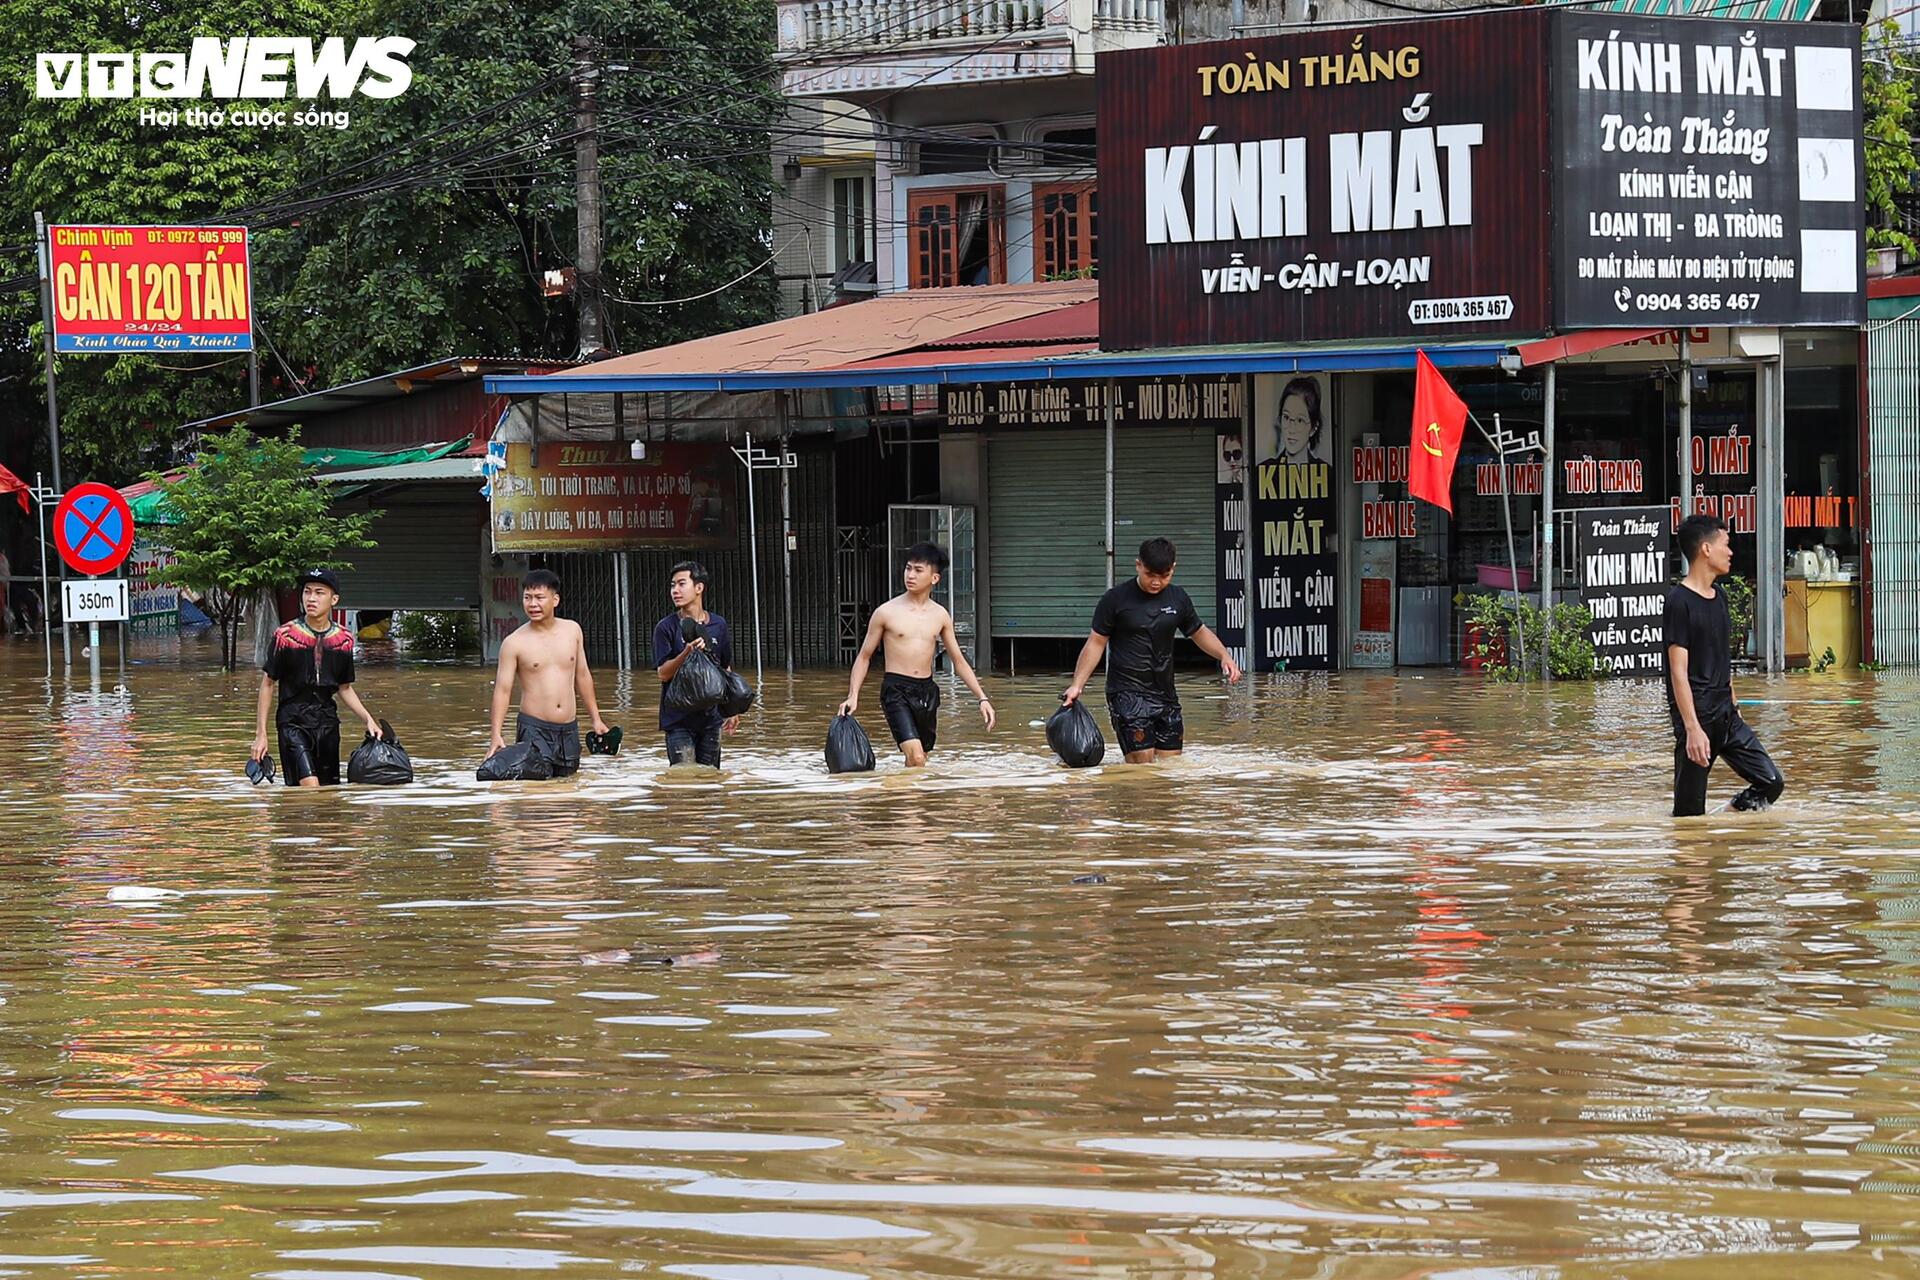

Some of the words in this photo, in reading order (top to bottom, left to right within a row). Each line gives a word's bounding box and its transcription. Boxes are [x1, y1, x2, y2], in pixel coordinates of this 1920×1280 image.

[1197, 52, 1290, 97] TOÀN
[1299, 34, 1420, 87] THẮNG
[1578, 30, 1681, 93] KÍNH
[1695, 30, 1786, 97] MẮT
[1600, 112, 1671, 153] Toàn
[1681, 109, 1770, 165] Thắng
[1145, 125, 1308, 244] KÍNH
[1329, 92, 1484, 233] MẮT
[1619, 168, 1664, 197] KÍNH
[1668, 165, 1709, 198] VIỄN
[1716, 170, 1752, 204] CẬN
[102, 229, 134, 250] Vịnh
[148, 231, 164, 243] ĐT:
[168, 231, 195, 243] 0972
[198, 231, 219, 243] 605
[222, 231, 242, 243] 999
[1589, 212, 1638, 242] LOẠN
[1643, 213, 1672, 242] THỊ
[1694, 214, 1720, 238] ĐA
[1724, 208, 1783, 238] TRÒNG
[56, 250, 122, 321] CÂN
[126, 263, 183, 321] 120
[185, 245, 246, 320] TẤN
[1200, 253, 1261, 294] VIỄN
[1278, 253, 1340, 294] CẬN
[1355, 256, 1431, 290] LOẠN
[1579, 258, 1594, 278] ĐO
[1597, 252, 1621, 278] MẮT
[1625, 250, 1655, 278] BẰNG
[1658, 254, 1683, 278] MÁY
[1685, 258, 1700, 278] ĐO
[1703, 255, 1729, 282] ĐIỆN
[1732, 251, 1747, 279] TỬ
[1748, 258, 1763, 282] TỰ
[1764, 255, 1794, 282] ĐỘNG
[1414, 304, 1431, 320] ĐT:
[1432, 302, 1460, 319] 0904
[1463, 301, 1484, 318] 365
[1487, 299, 1507, 316] 467
[1636, 294, 1682, 311] 0904
[1687, 294, 1721, 310] 365
[1726, 294, 1760, 310] 467
[124, 323, 183, 333] 24/24
[947, 384, 984, 426] BALÔ
[999, 383, 1027, 424] DÂY
[1138, 378, 1162, 420] MŨ
[1353, 438, 1385, 484] BÁN
[1388, 447, 1411, 483] BU
[1709, 424, 1751, 475] MẮT
[540, 473, 556, 496] TÚI
[1258, 457, 1329, 500] KÍNH
[1513, 453, 1544, 495] MẮT
[1564, 455, 1597, 493] THỜI
[1599, 459, 1643, 493] TRANG
[1223, 494, 1244, 531] KÍN
[1363, 494, 1396, 538] BÁN
[1591, 519, 1620, 537] Toàn
[1623, 515, 1660, 538] Thắng
[1784, 490, 1811, 527] KÍNH
[1815, 486, 1842, 528] MẮT
[1263, 506, 1324, 556] MẮT
[1586, 548, 1626, 587] KÍNH
[1630, 541, 1665, 585] MẮT
[79, 593, 114, 610] 350m
[1259, 566, 1291, 609] VIỄN
[1304, 569, 1334, 613] CẬN
[1587, 593, 1618, 619] THỜI
[1621, 594, 1665, 618] TRANG
[1266, 625, 1302, 663] LOẠN
[1306, 624, 1328, 662] THỊ
[1592, 623, 1626, 646] VIỄN
[1630, 625, 1663, 647] CẬN
[1639, 652, 1662, 671] THỊ
